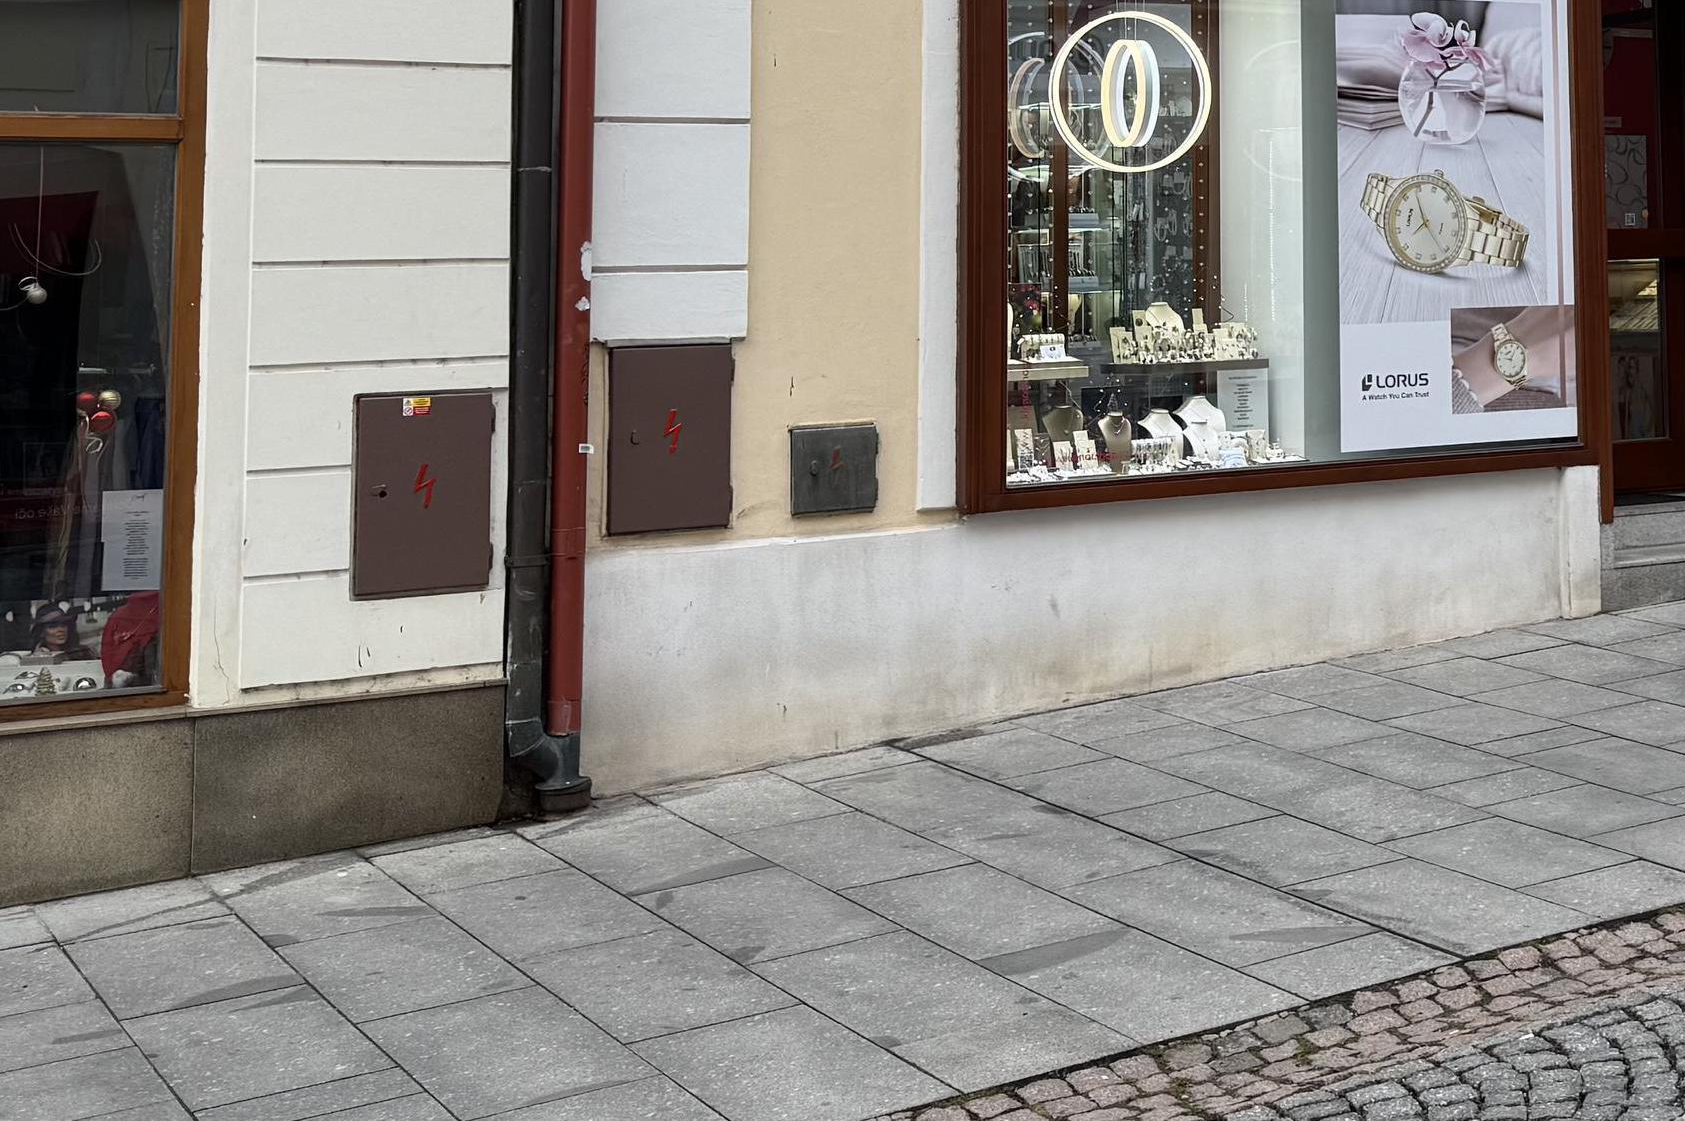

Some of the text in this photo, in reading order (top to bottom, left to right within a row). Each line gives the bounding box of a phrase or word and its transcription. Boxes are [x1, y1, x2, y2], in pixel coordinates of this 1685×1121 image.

[1375, 372, 1430, 389] LORUS
[1368, 392, 1388, 401] Watch
[1388, 392, 1400, 400] You
[1401, 391, 1414, 399] Can
[1415, 390, 1430, 398] Trust
